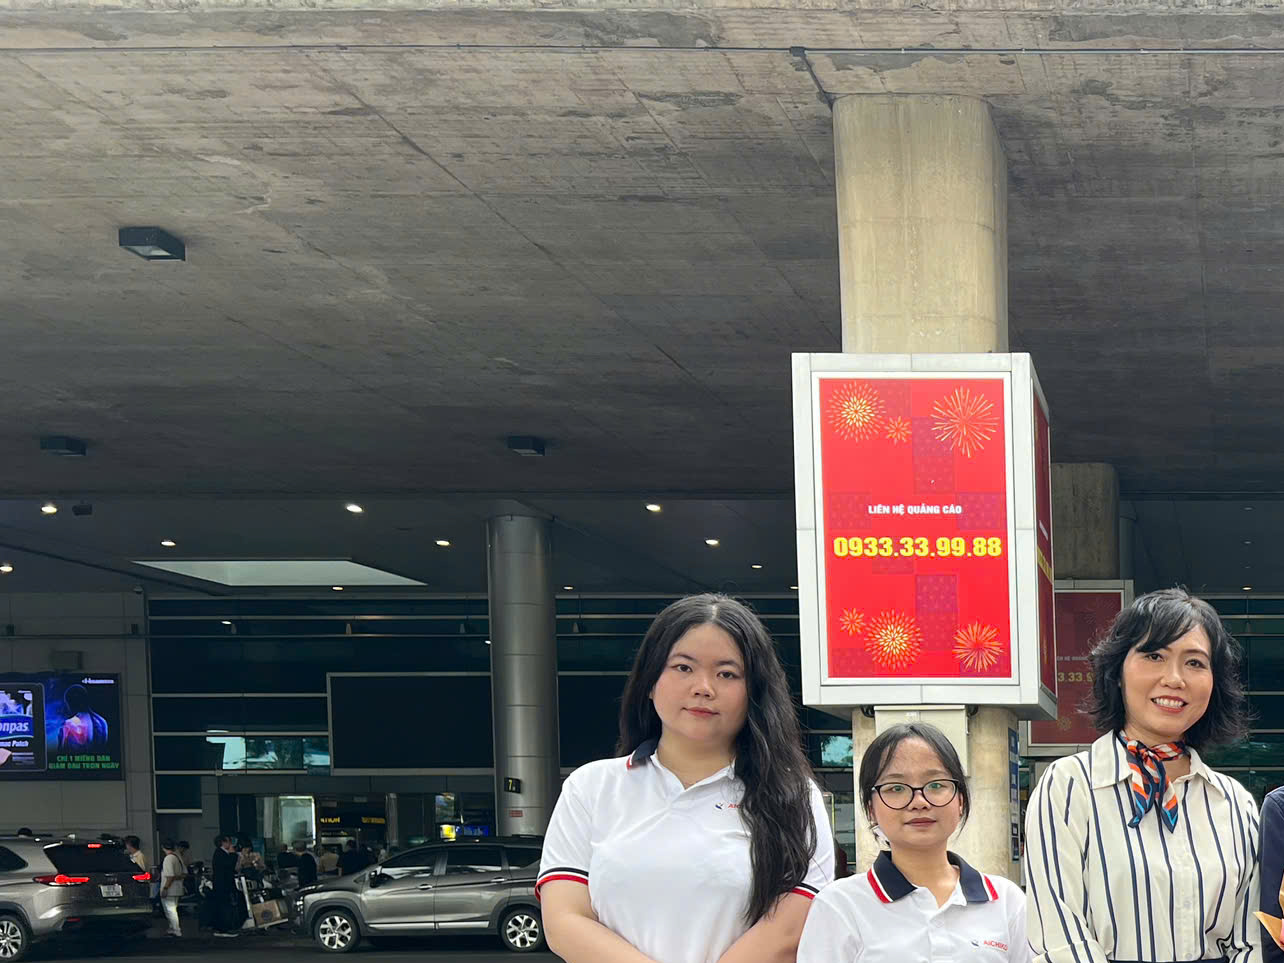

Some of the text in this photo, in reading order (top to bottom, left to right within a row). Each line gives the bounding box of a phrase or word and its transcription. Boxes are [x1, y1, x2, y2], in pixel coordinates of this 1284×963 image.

[868, 503, 963, 516] LIÊN HỆ QUẢNG CÁO
[833, 537, 1002, 557] 0933.33.99.88
